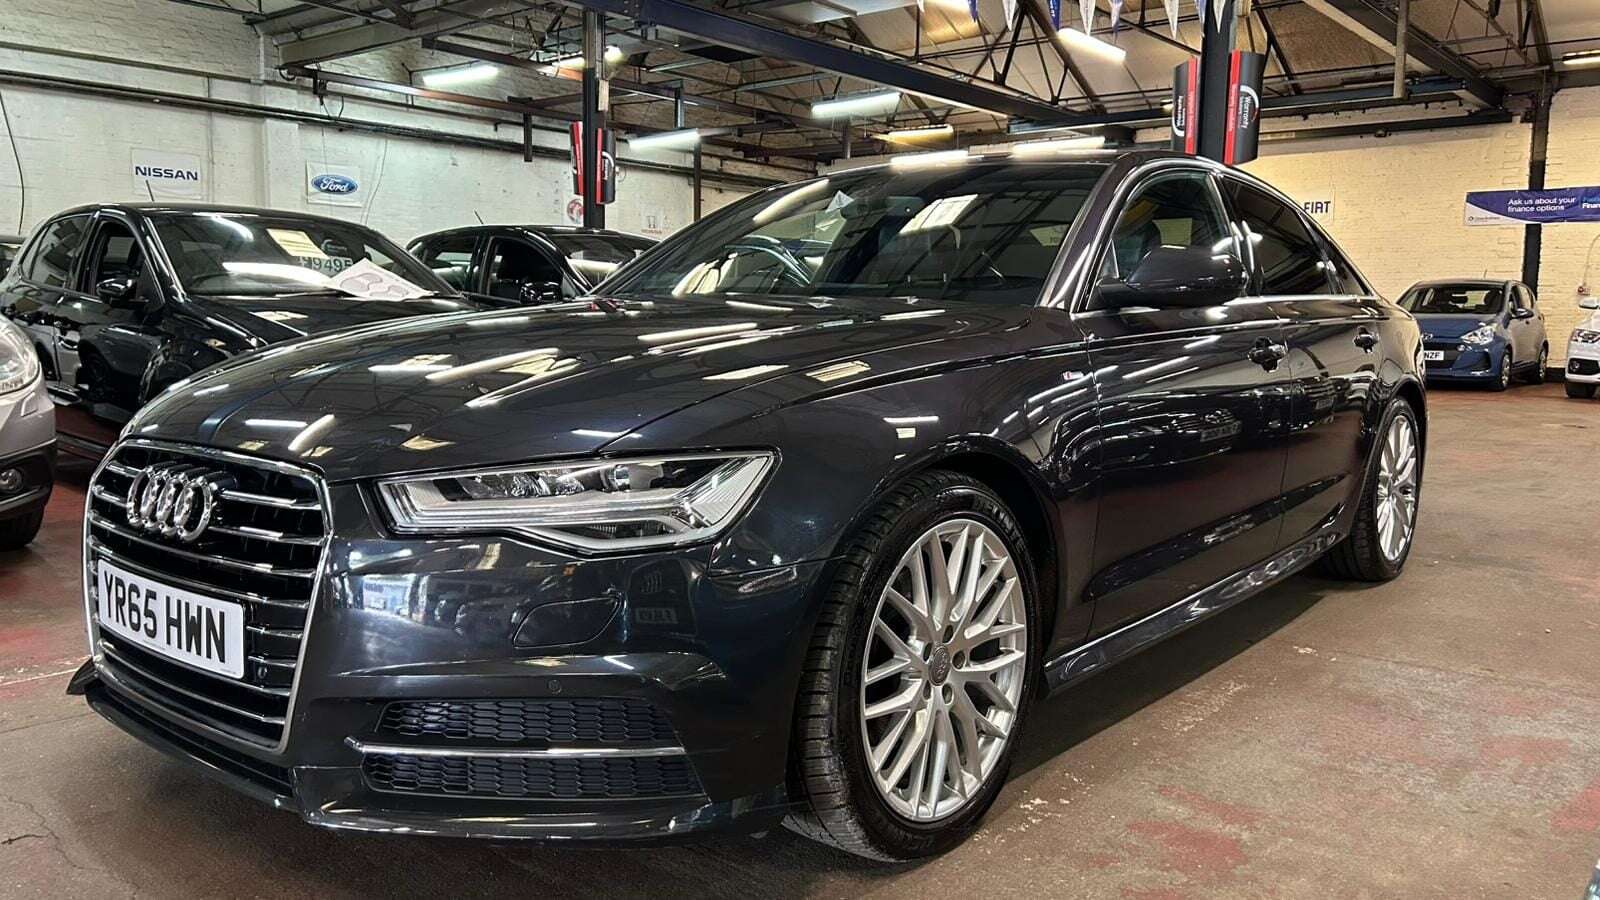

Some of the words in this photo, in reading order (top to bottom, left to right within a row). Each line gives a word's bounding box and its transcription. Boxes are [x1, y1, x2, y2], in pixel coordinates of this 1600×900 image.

[135, 166, 198, 181] NISSAN
[320, 176, 349, 192] Ford
[1304, 201, 1331, 213] FIAT
[1535, 197, 1557, 205] about
[1559, 196, 1577, 205] your
[1536, 204, 1565, 213] options
[104, 570, 157, 639] YR65
[165, 595, 225, 664] HWN
